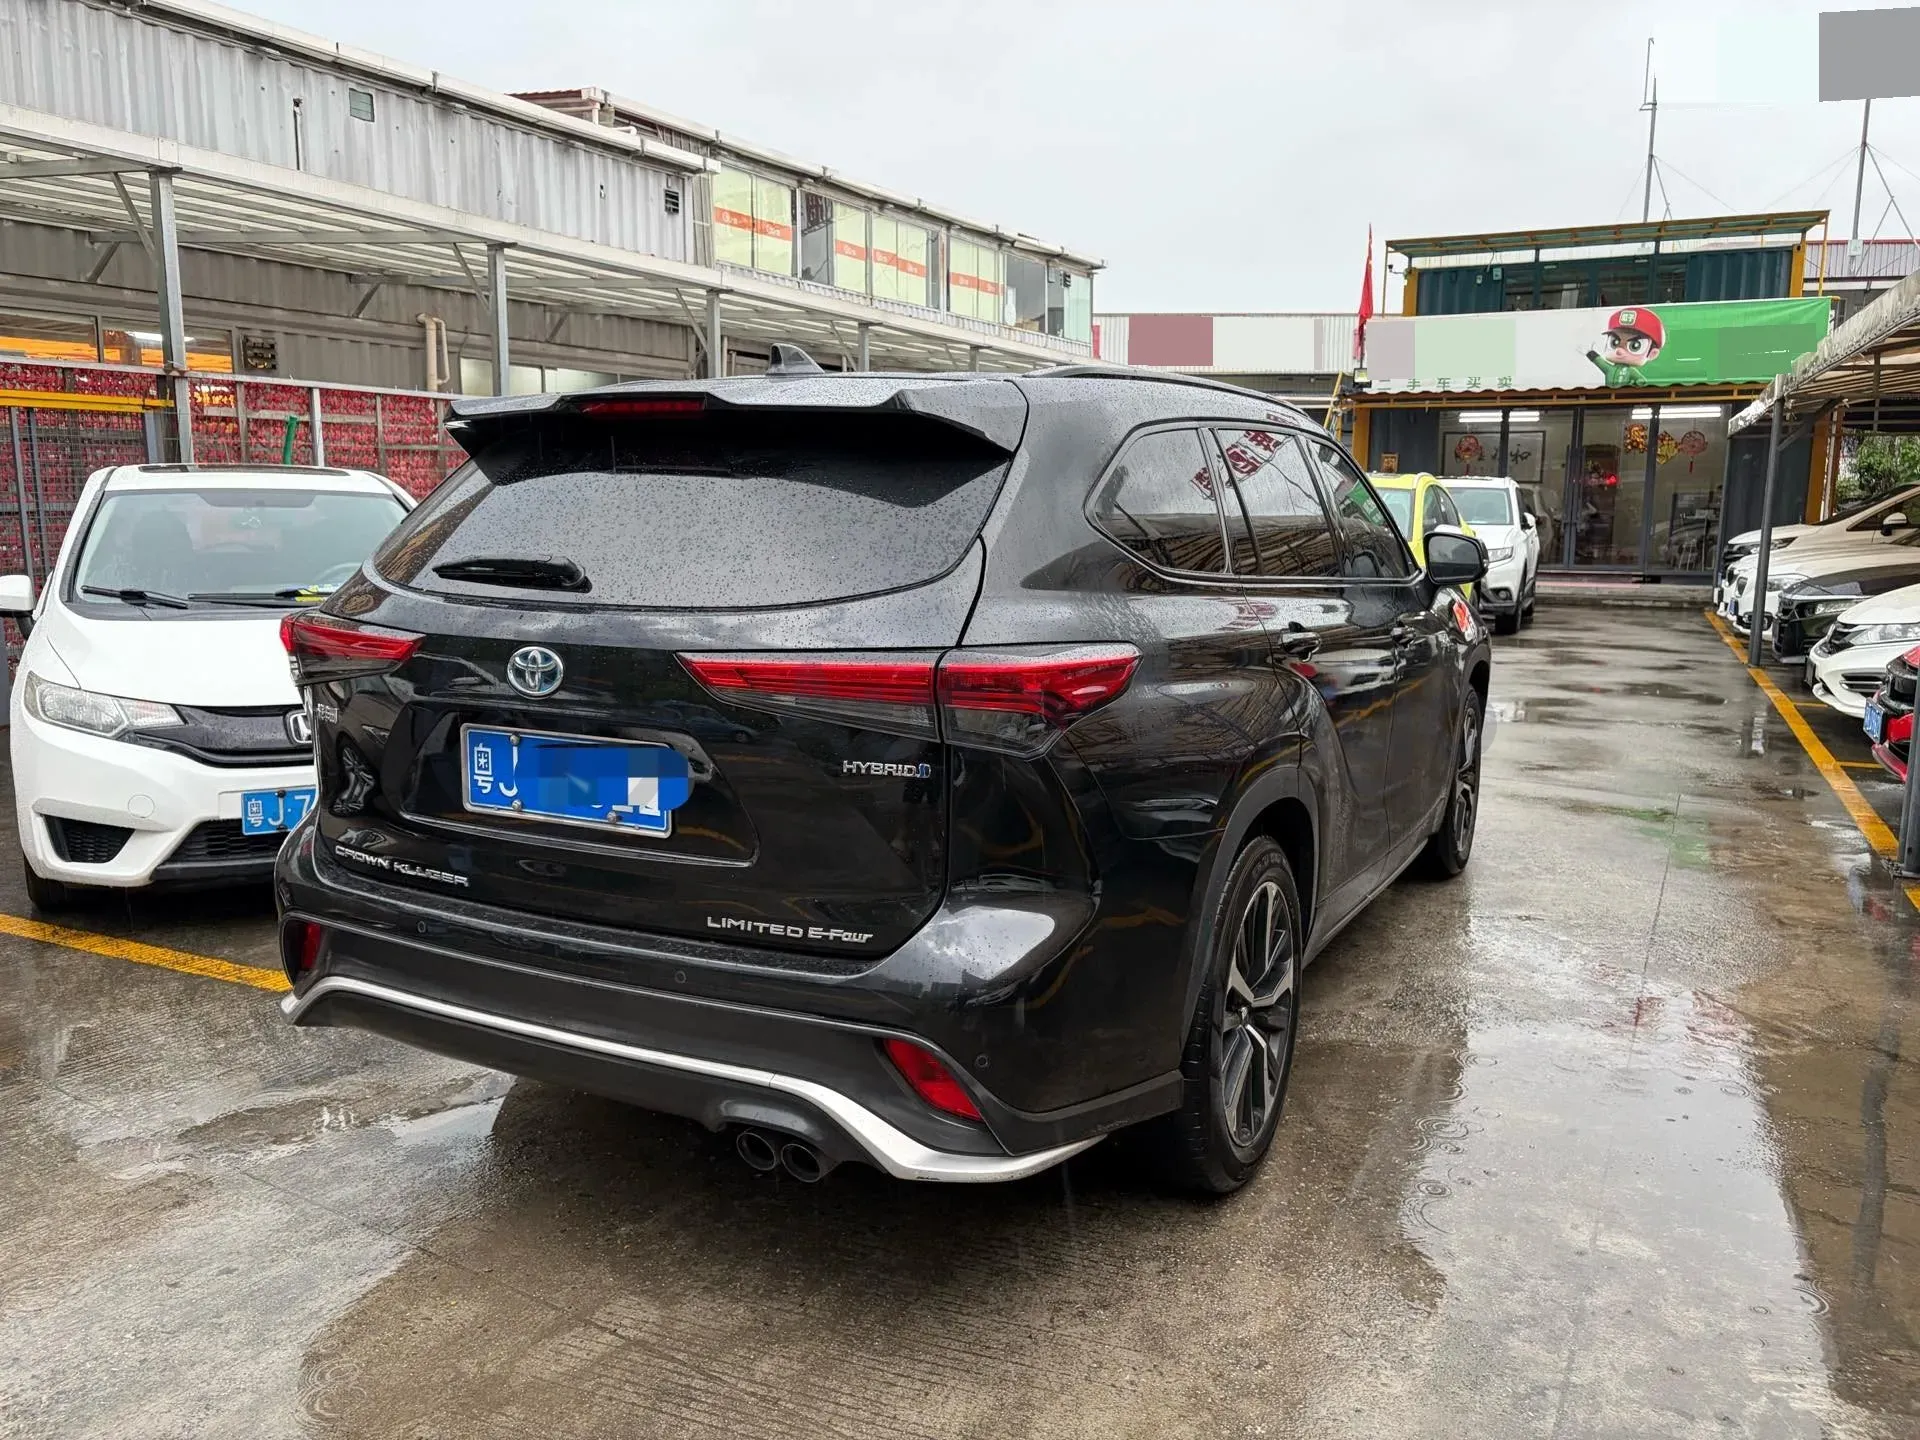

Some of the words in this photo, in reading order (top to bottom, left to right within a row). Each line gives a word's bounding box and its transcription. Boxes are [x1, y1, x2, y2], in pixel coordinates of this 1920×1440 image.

[1377, 376, 1513, 391] 二手车买卖
[843, 760, 917, 777] HYBRID
[335, 845, 390, 870] CROWN
[393, 861, 469, 887] KLUGER
[707, 916, 803, 938] LIMITED
[807, 926, 874, 944] E-Four
